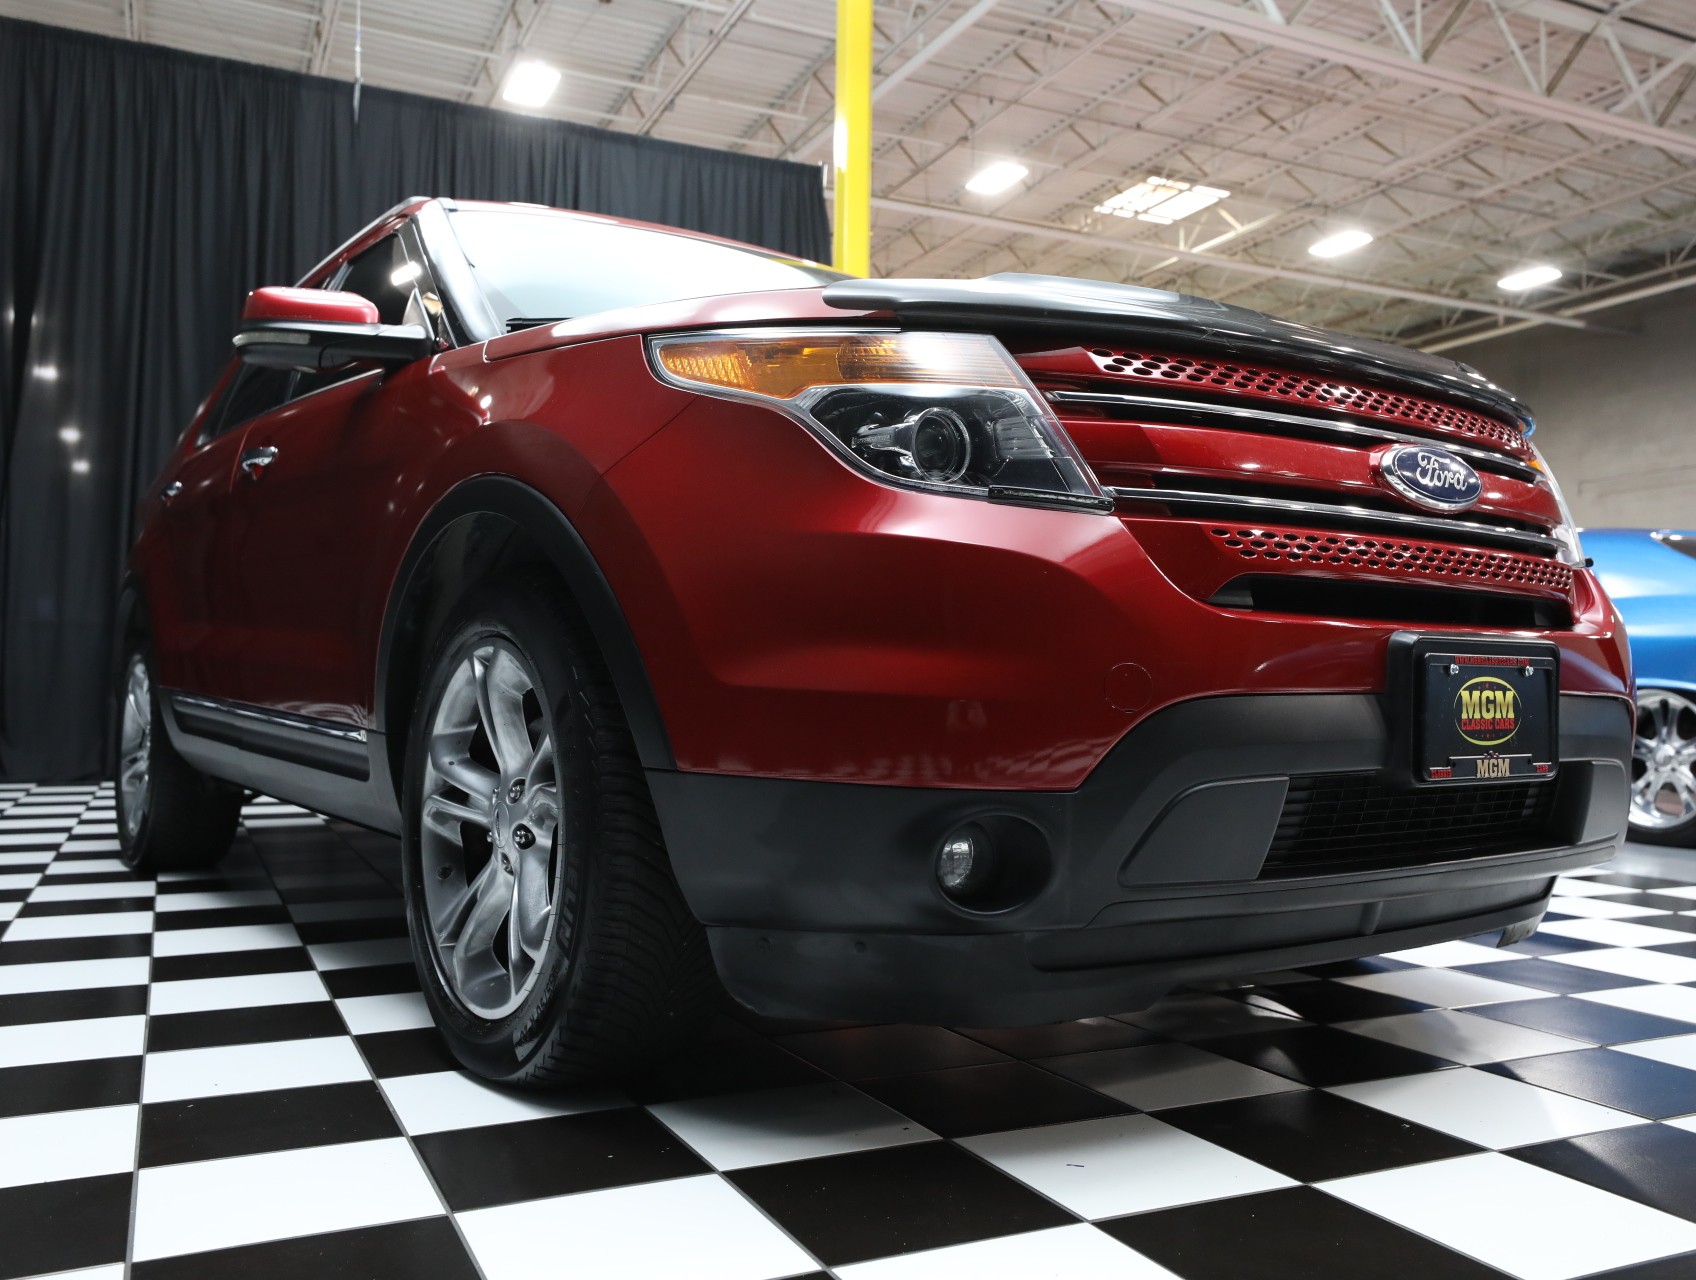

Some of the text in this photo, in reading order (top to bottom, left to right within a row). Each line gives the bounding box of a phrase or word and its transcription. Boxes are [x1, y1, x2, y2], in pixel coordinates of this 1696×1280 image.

[1416, 452, 1467, 490] Ford
[1461, 690, 1515, 719] MGM
[1461, 718, 1515, 730] CLASSIC CARS
[1476, 758, 1510, 778] MGM
